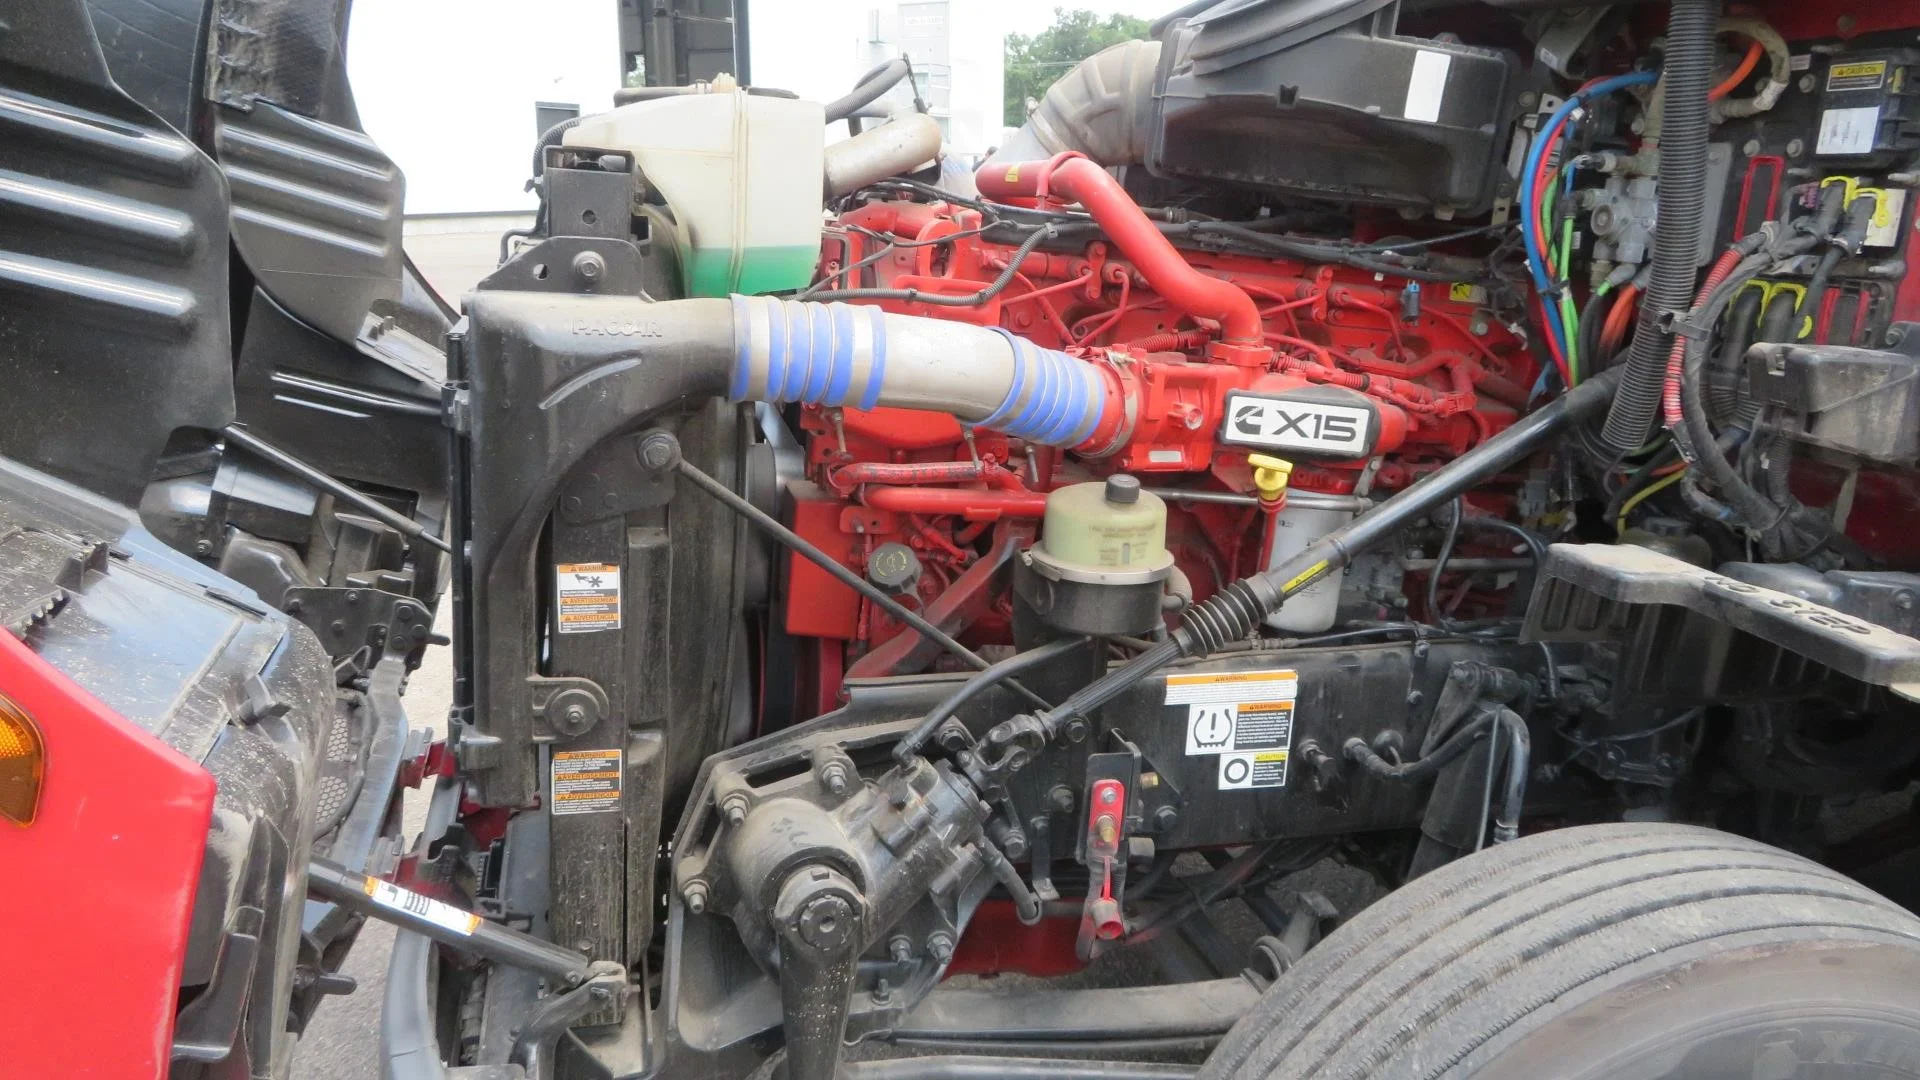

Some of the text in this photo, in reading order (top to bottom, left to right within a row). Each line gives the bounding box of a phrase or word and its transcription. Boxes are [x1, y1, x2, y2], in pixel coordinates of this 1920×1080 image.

[571, 318, 663, 338] PACCAR
[1272, 409, 1358, 443] X15
[1769, 598, 1872, 635] STEP
